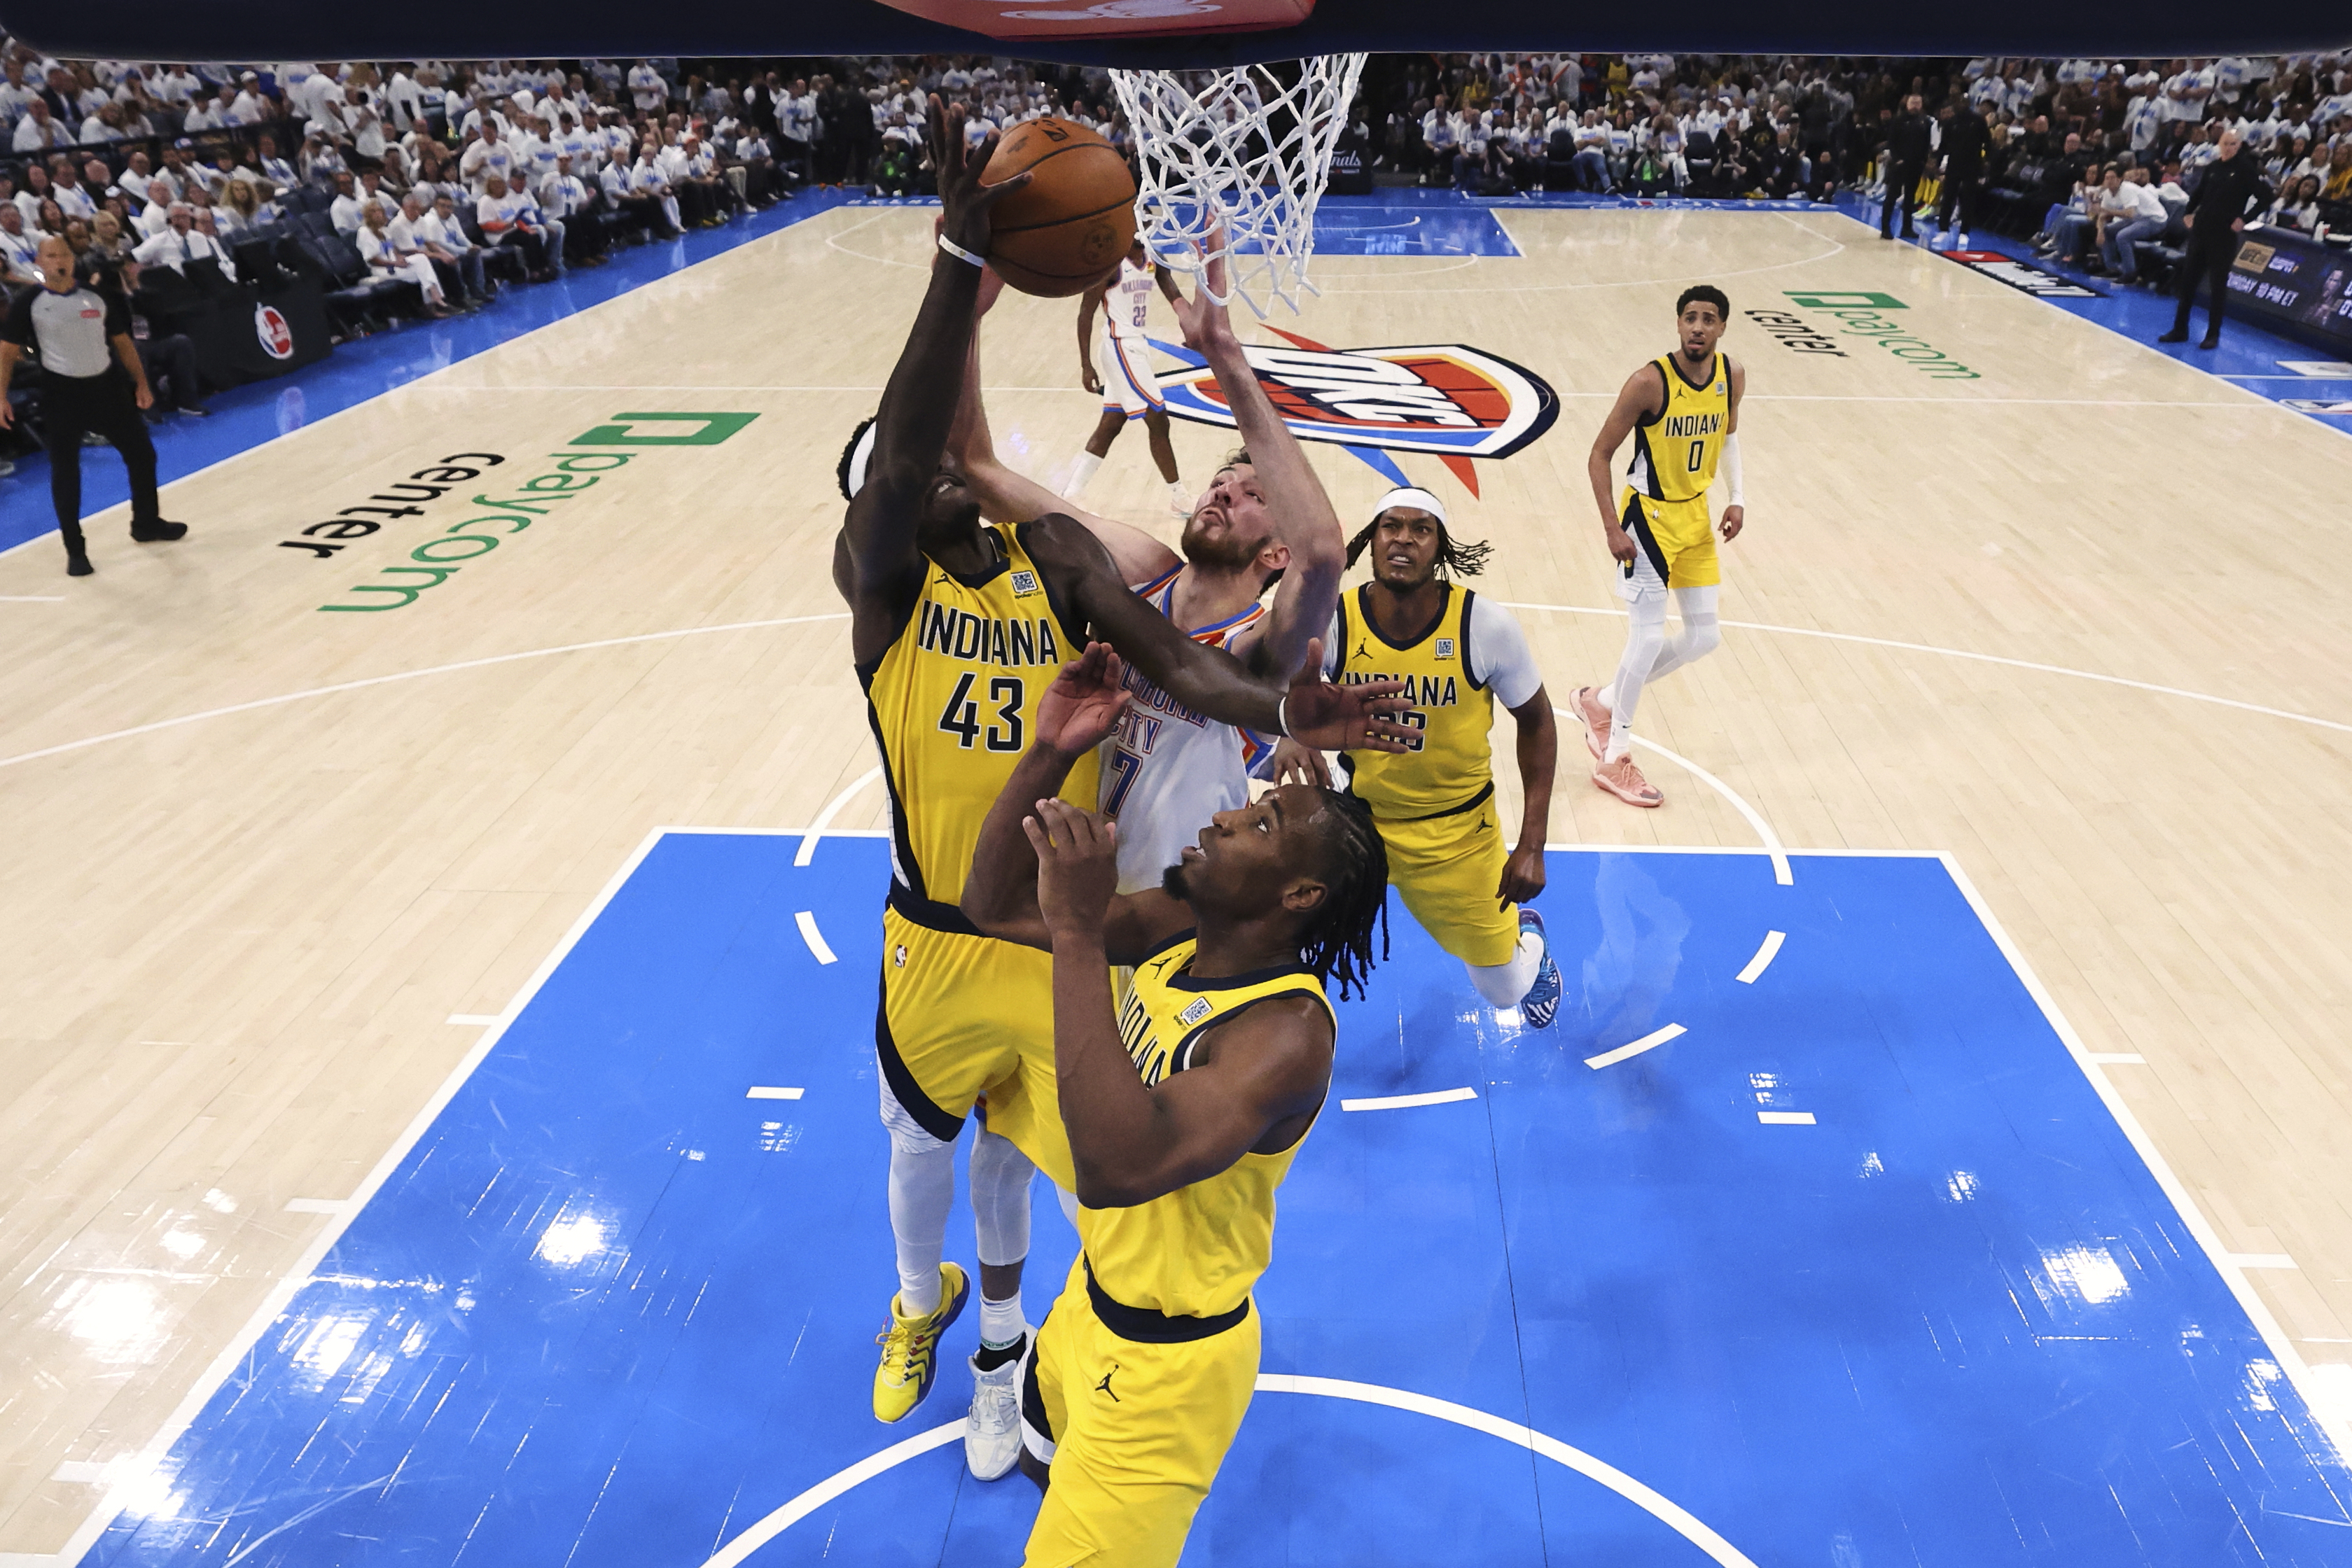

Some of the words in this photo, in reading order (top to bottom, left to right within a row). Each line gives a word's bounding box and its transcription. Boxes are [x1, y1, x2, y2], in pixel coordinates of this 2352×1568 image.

[1744, 309, 1851, 358] center
[1811, 310, 1982, 379] paycom
[1688, 440, 1705, 473] 0
[276, 452, 506, 559] center
[315, 451, 639, 612] paycom
[917, 598, 1059, 668] INDIANA
[937, 671, 1024, 753] 43
[1344, 672, 1458, 707] IIANA
[1104, 745, 1143, 818] 7
